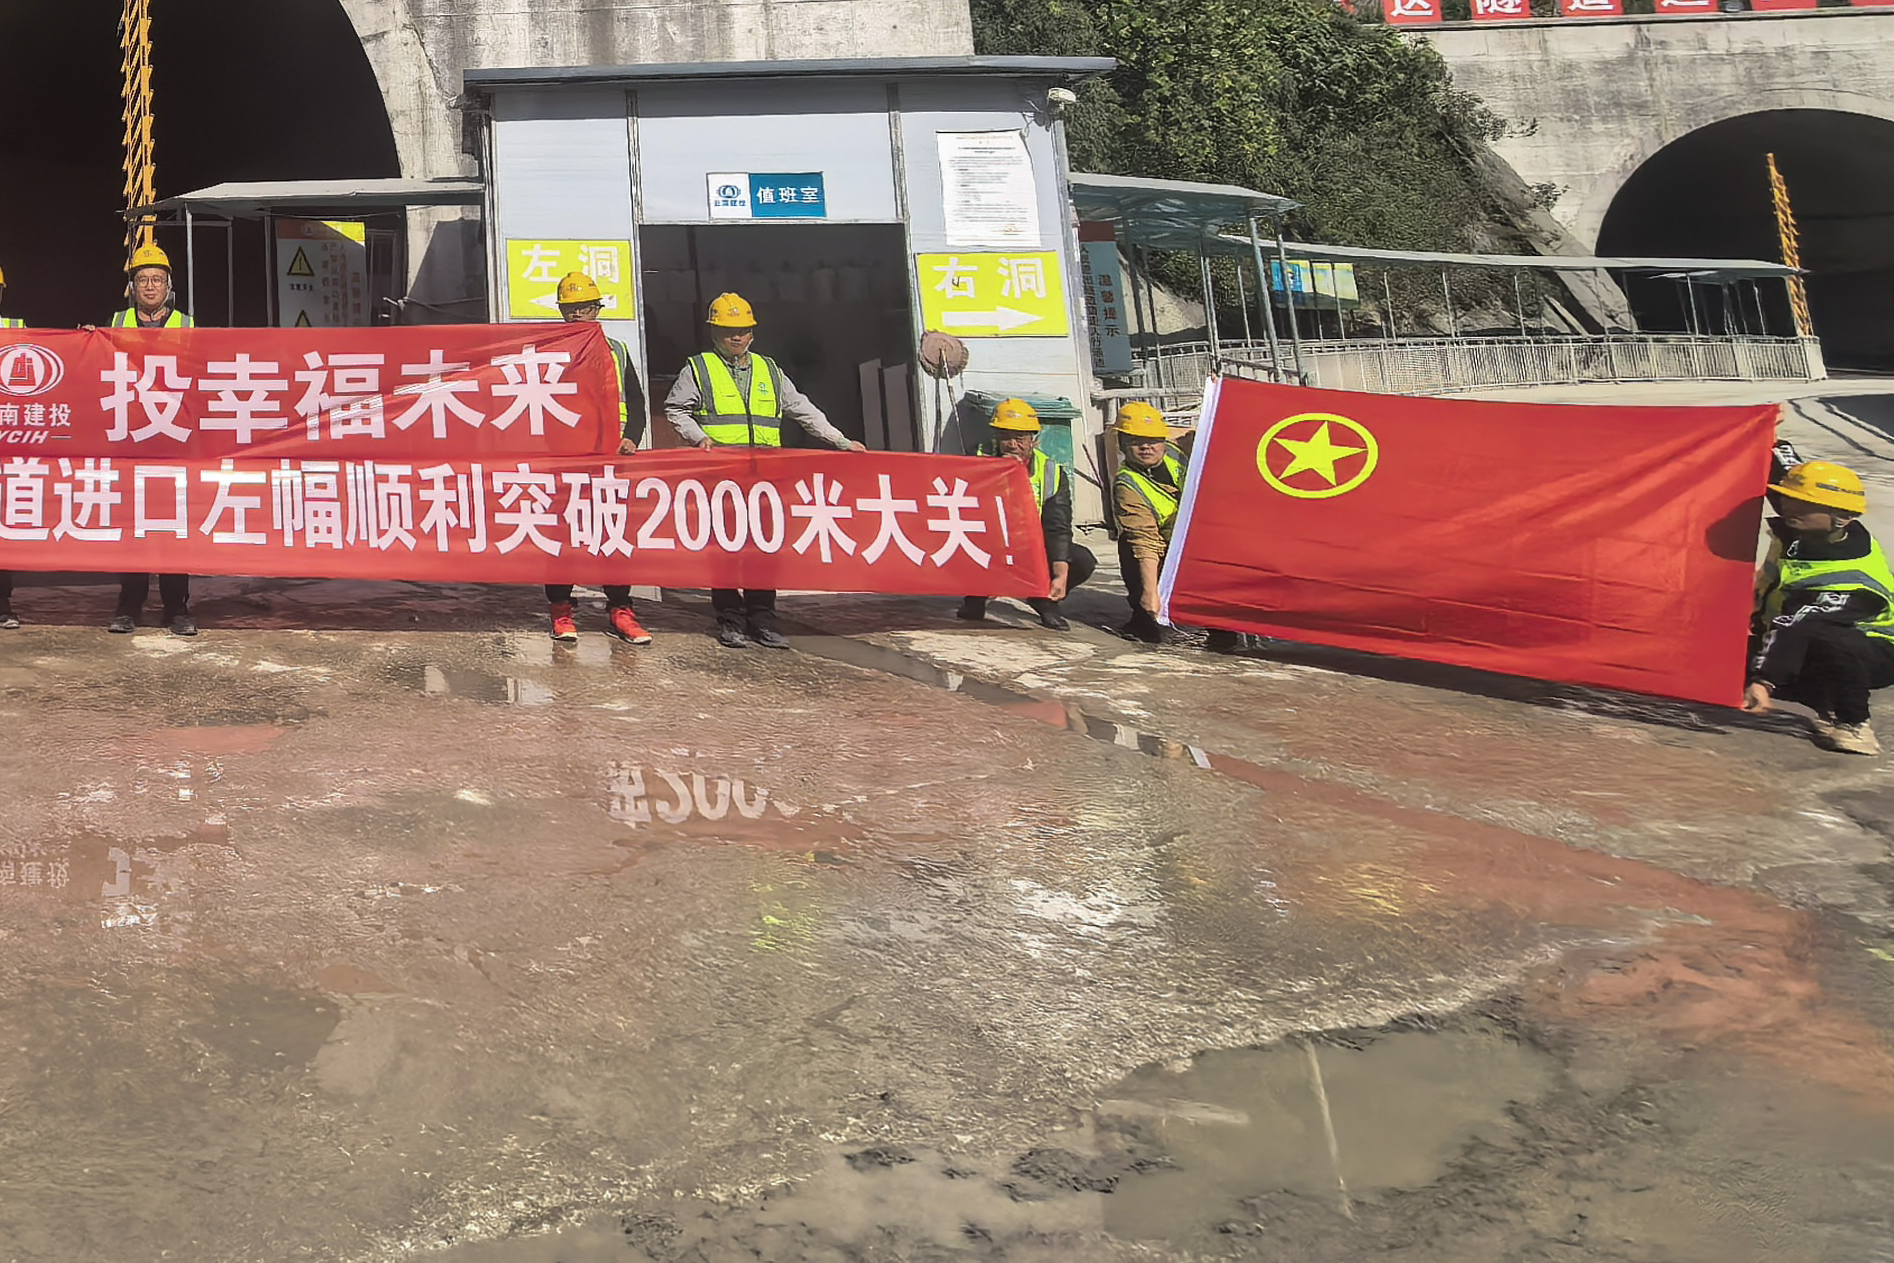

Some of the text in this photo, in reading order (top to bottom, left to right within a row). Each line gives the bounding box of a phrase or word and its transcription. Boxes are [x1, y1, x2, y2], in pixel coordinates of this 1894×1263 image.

[756, 186, 820, 204] 值班室
[522, 244, 620, 283] 左洞
[932, 257, 1046, 299] 右洞
[100, 344, 584, 445] 投幸福未来
